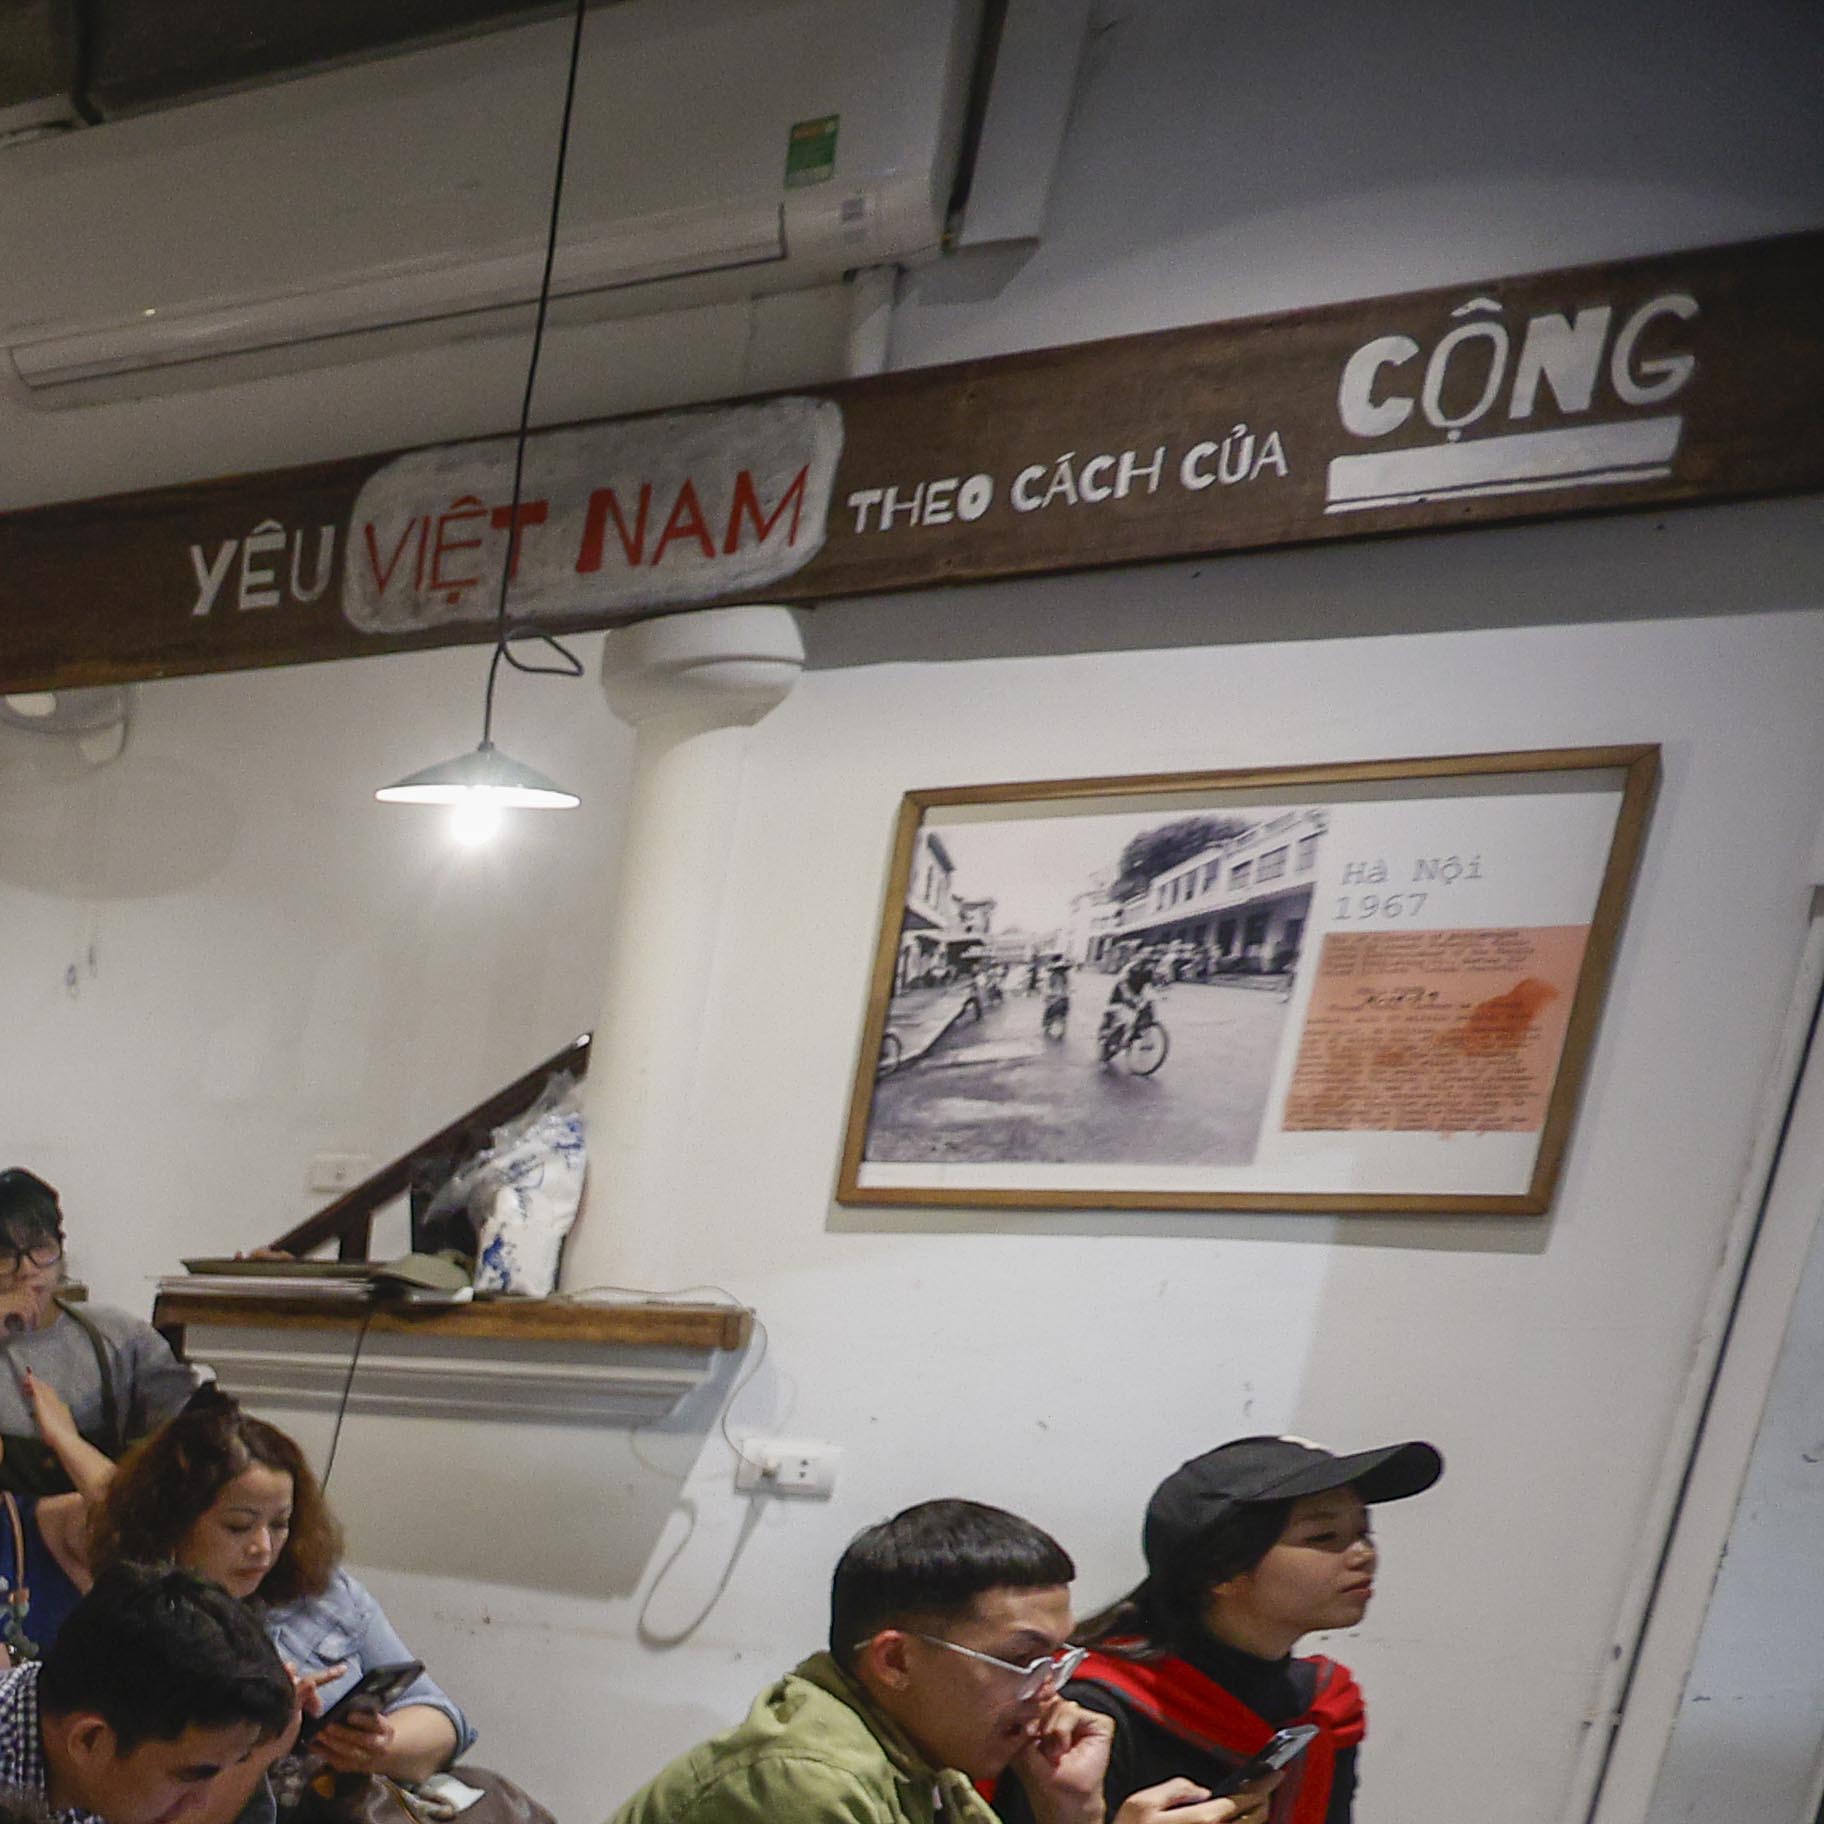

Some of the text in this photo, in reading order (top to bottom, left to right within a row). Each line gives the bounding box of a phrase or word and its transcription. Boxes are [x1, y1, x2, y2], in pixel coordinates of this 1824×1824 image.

[189, 293, 1701, 616] YÊU VIỆT NAM THEO CÁCH CỦA CỘNG
[1341, 854, 1483, 886] Hà Nội
[1331, 891, 1430, 921] 1967
